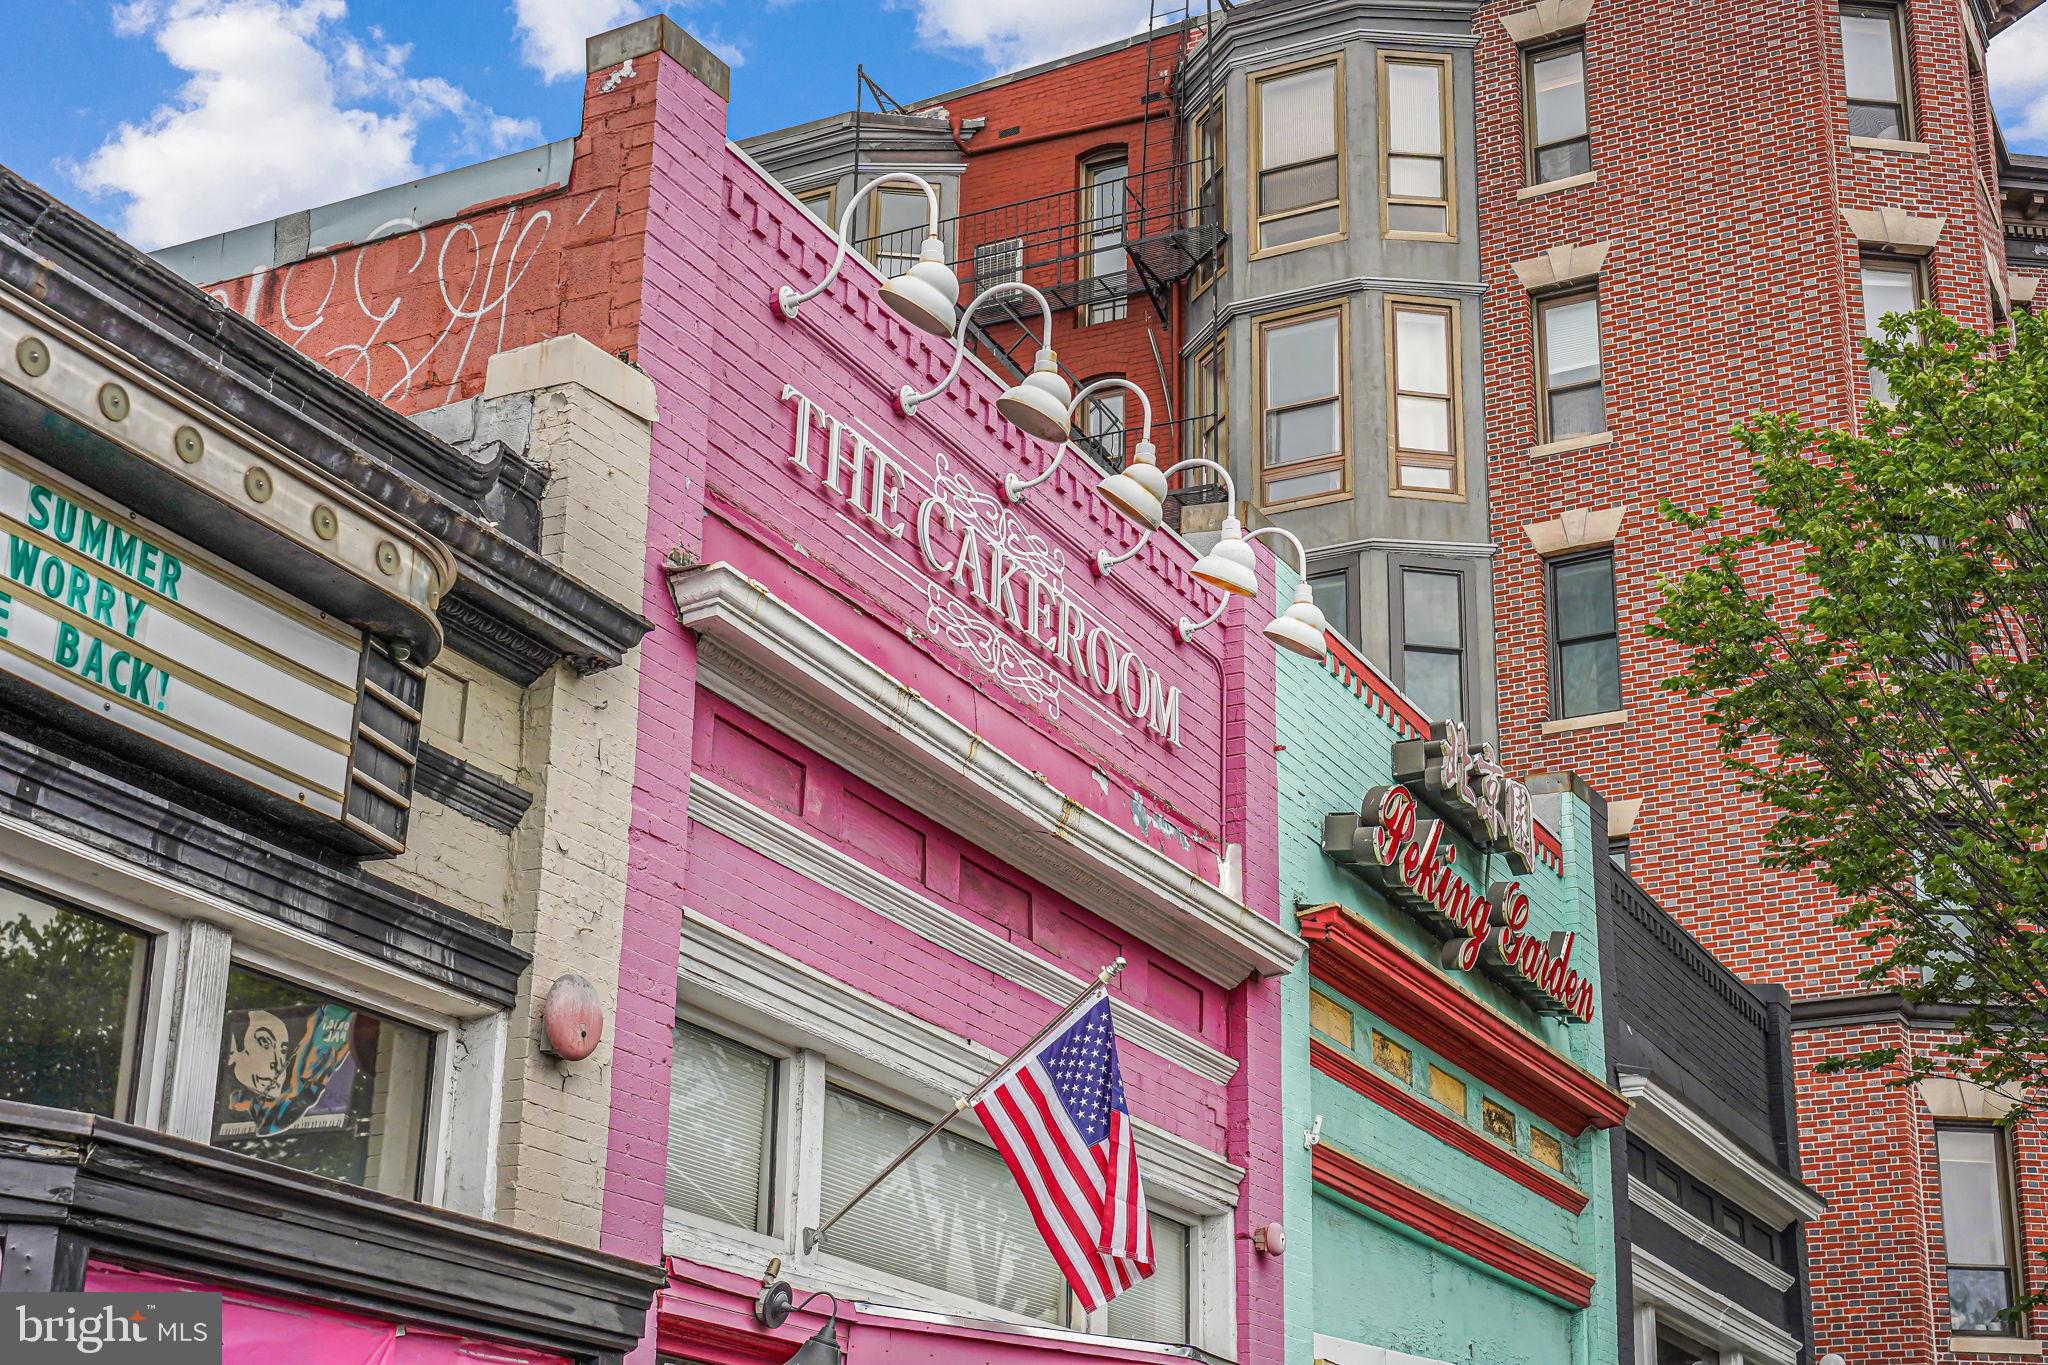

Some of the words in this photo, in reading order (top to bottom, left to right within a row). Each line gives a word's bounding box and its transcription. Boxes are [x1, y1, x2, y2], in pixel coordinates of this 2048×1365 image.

[781, 384, 905, 539] THE
[9, 534, 146, 638] WORRY
[28, 485, 181, 600] SUMMER
[55, 621, 170, 711] BACK!
[1373, 784, 1493, 971] Peking
[1499, 882, 1595, 1023] Garden
